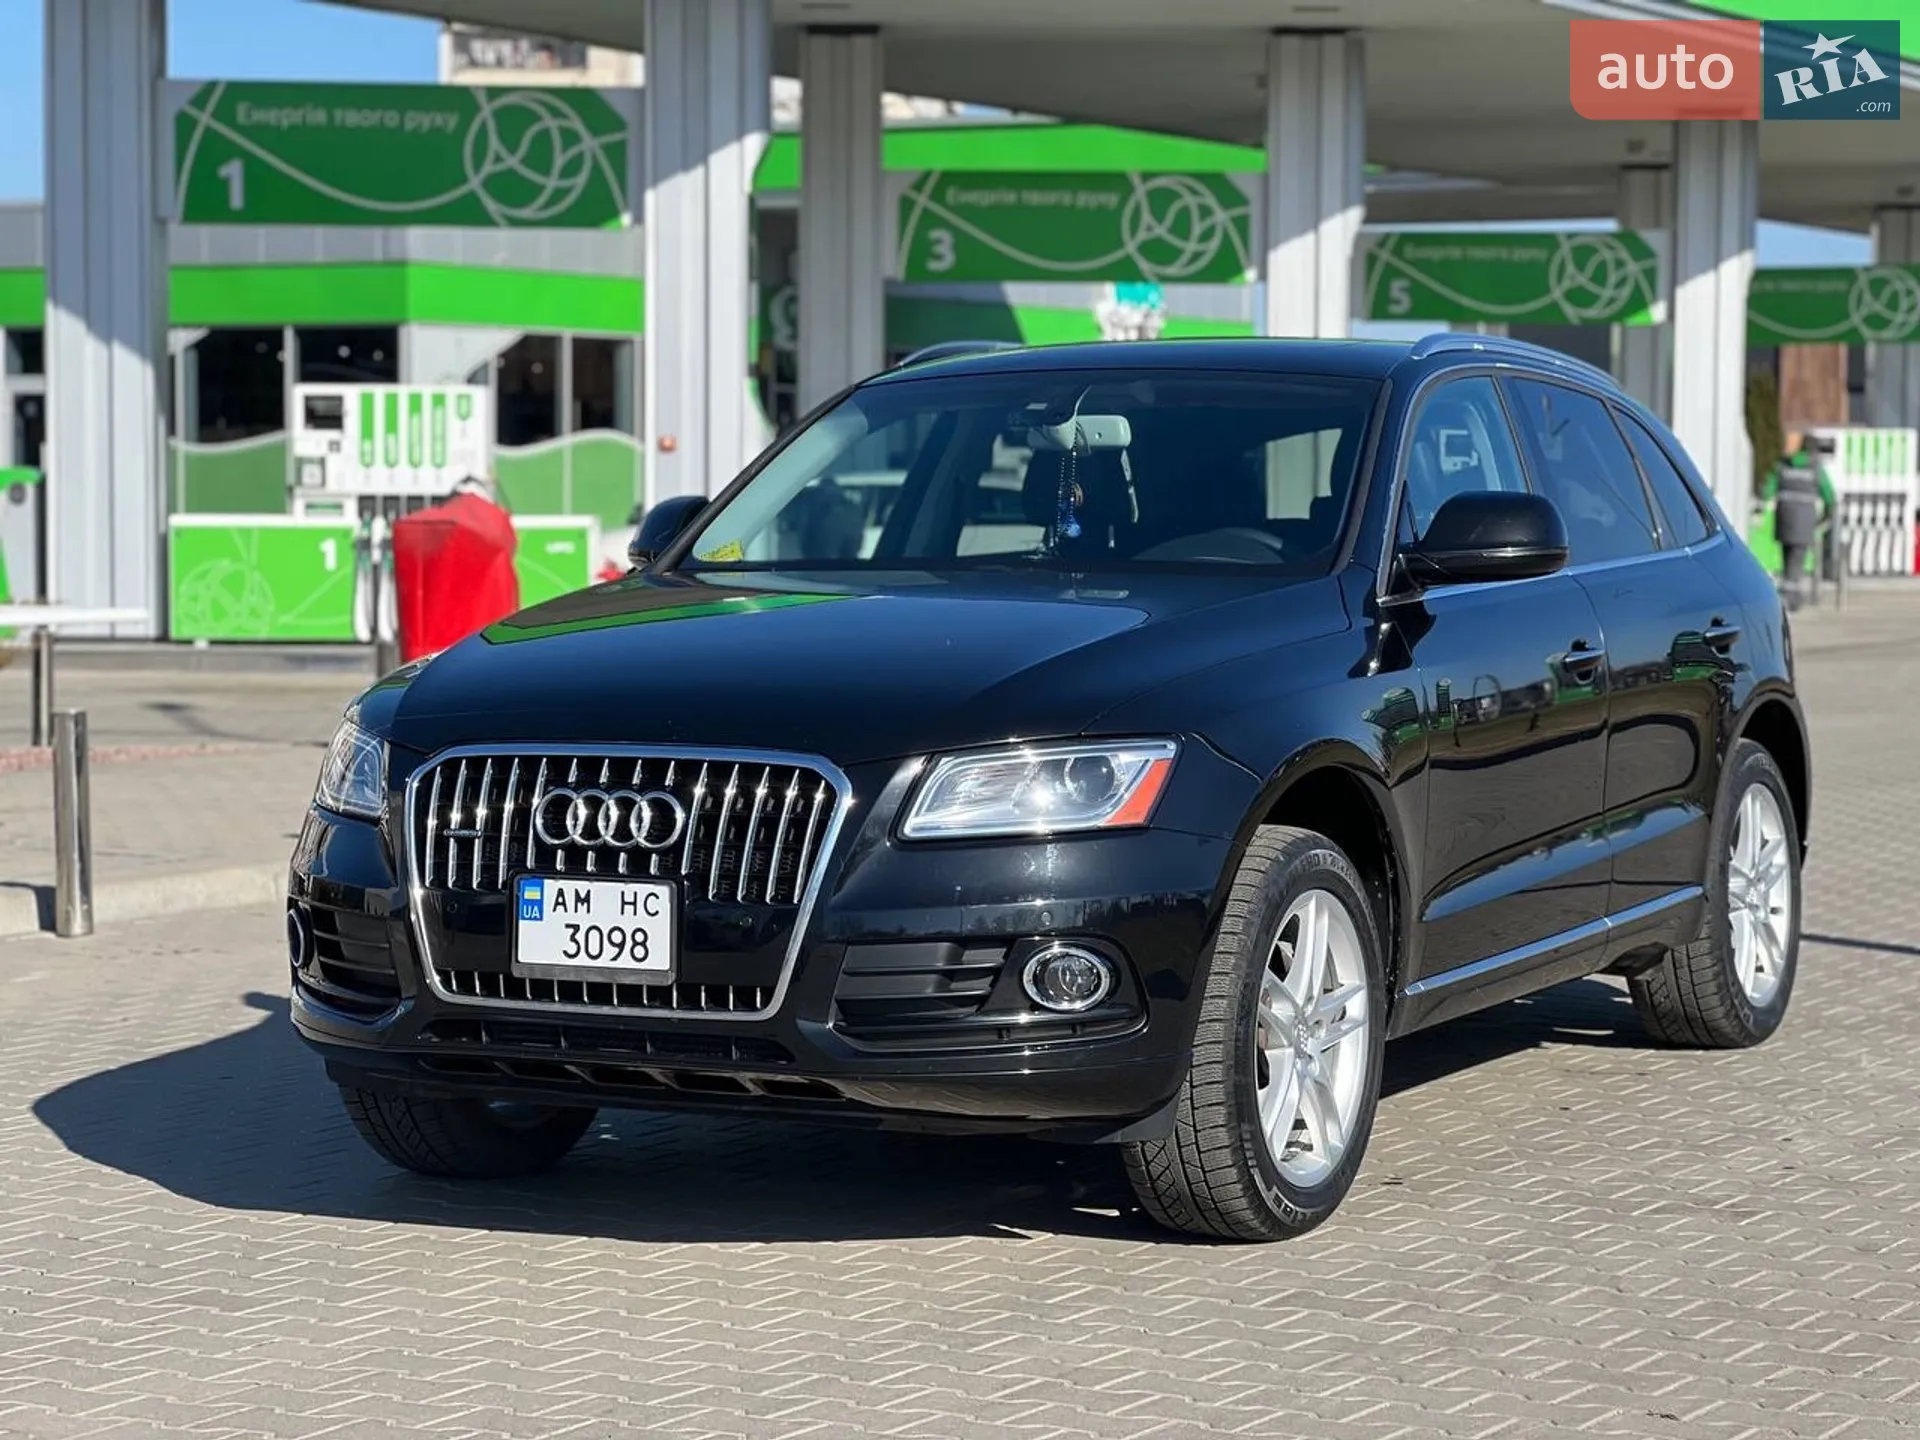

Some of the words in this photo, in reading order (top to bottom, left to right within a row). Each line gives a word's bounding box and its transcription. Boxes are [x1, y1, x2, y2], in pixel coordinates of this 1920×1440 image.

[236, 101, 327, 131] Енергія
[333, 107, 401, 129] твого
[403, 110, 460, 133] руху
[217, 157, 245, 211] 1
[925, 227, 957, 272] 3
[1387, 278, 1413, 315] 5
[318, 537, 338, 573] 1
[523, 905, 540, 919] UA
[552, 886, 592, 915] AM
[620, 890, 660, 917] HC
[562, 922, 649, 963] 3098
